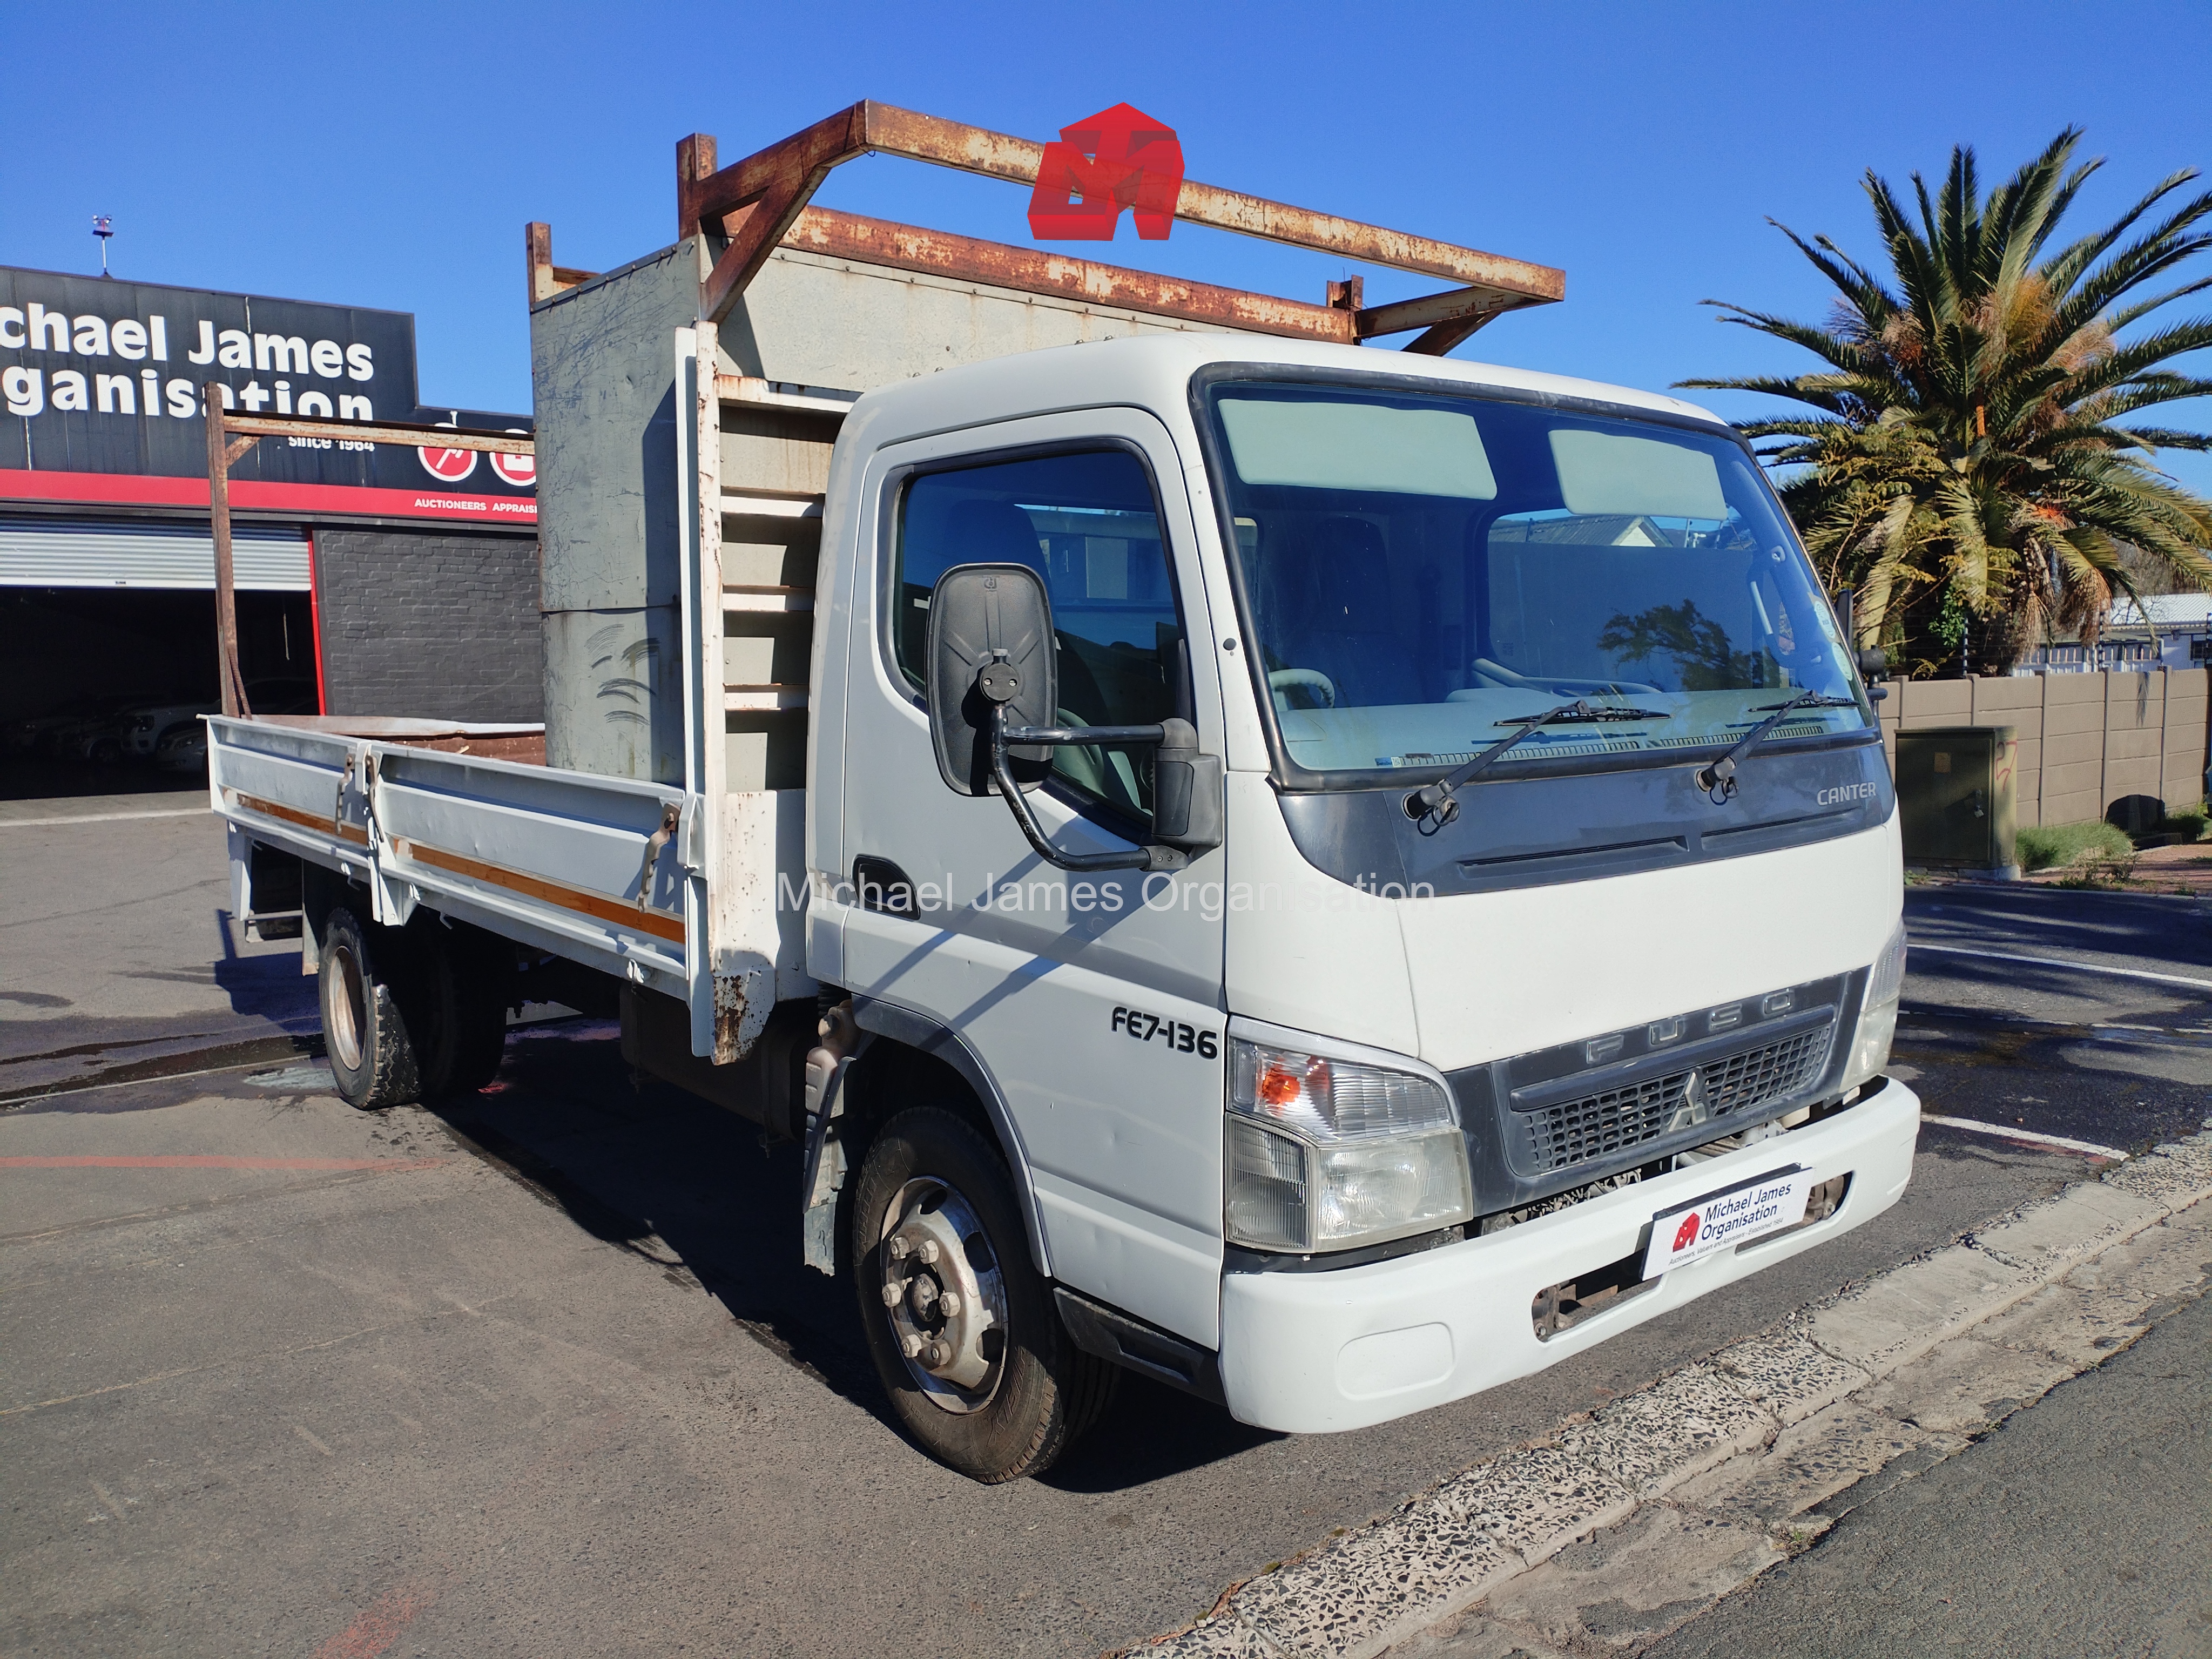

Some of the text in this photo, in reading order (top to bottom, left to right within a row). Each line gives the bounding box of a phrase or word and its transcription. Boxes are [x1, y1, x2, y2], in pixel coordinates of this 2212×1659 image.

[0, 302, 374, 381] chael James
[288, 436, 332, 449] since
[414, 498, 487, 511] AUCTIONEERS
[1817, 781, 1876, 806] CANTER
[1111, 1006, 1218, 1060] FE7-136
[1586, 989, 1793, 1064] FUSO
[1702, 1204, 1777, 1240] Organisation
[1704, 1183, 1792, 1223] Michael James
